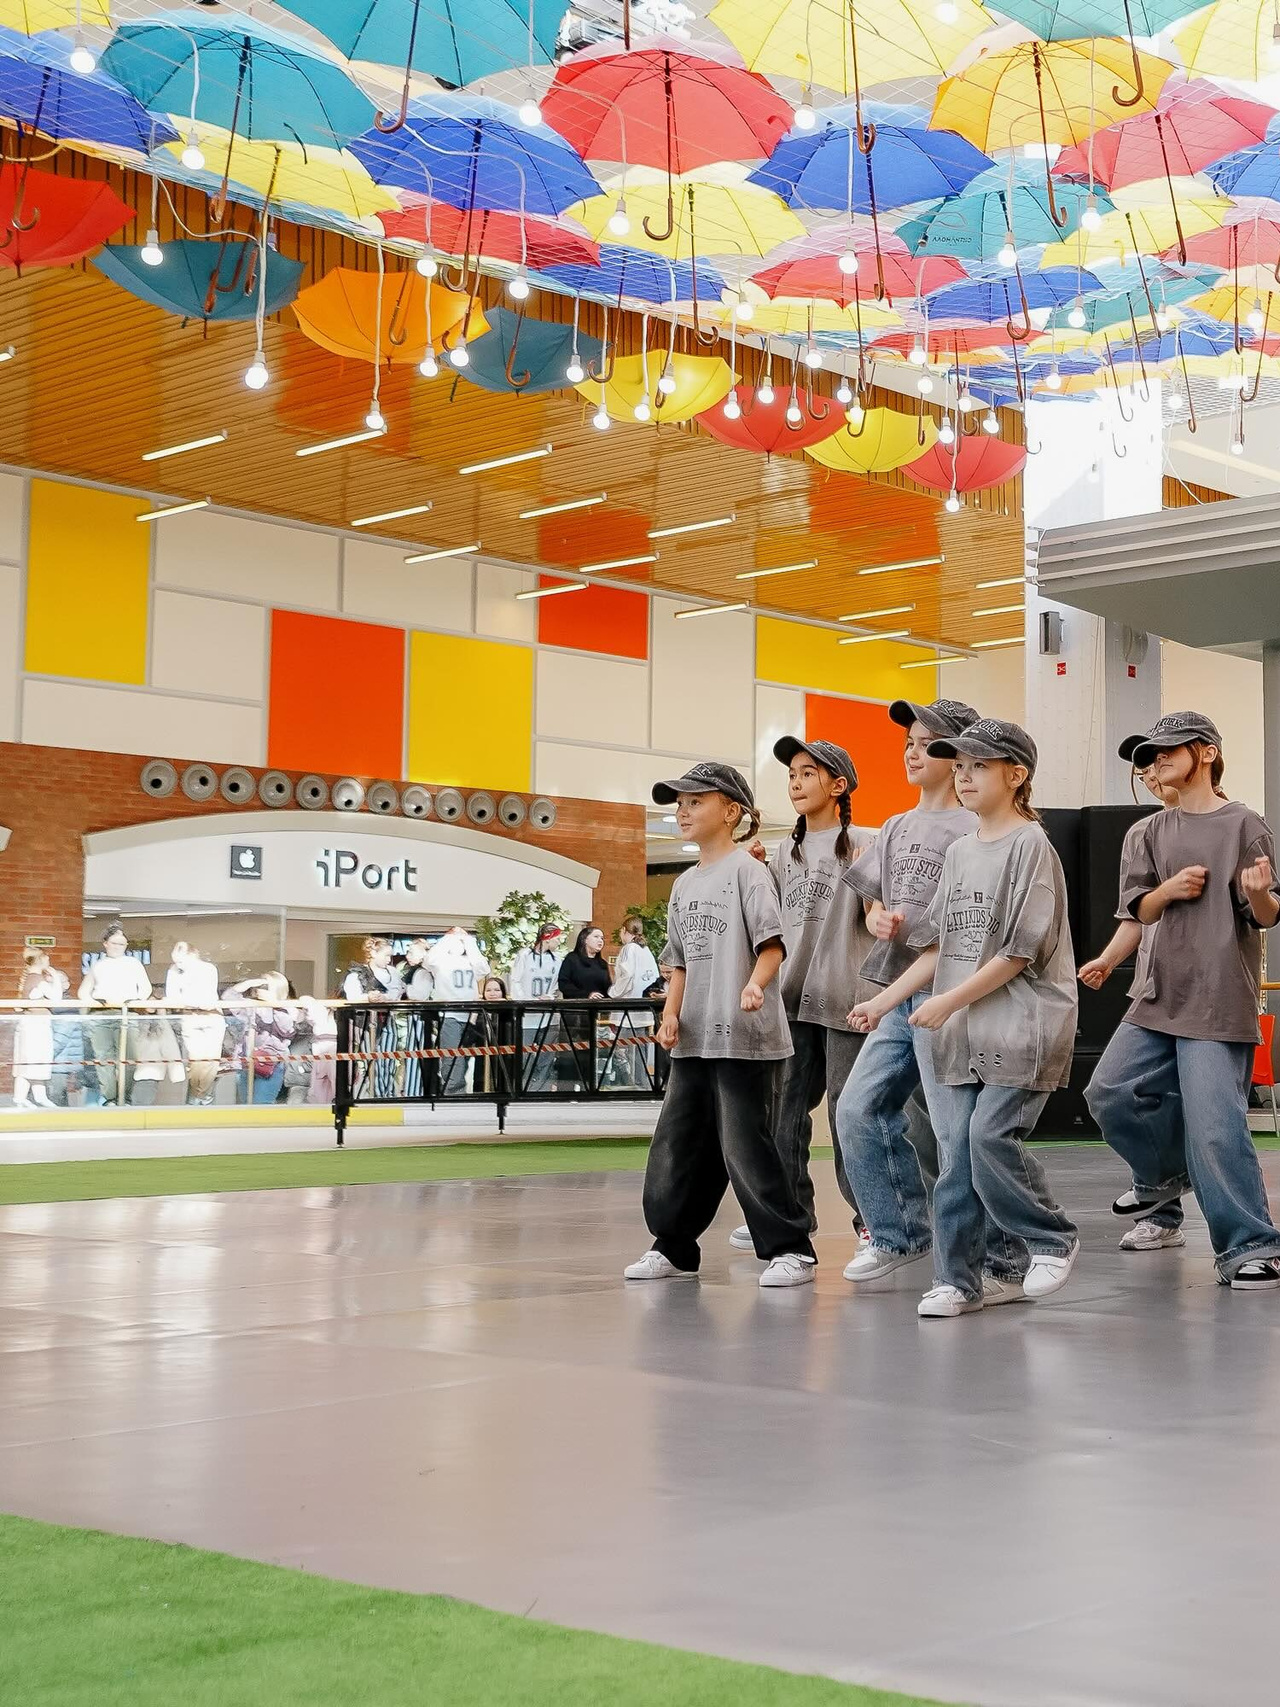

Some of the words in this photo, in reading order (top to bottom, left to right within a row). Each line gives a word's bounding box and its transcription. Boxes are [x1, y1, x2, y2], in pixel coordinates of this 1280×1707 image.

[315, 848, 418, 892] iPort
[452, 968, 475, 989] 07
[531, 976, 553, 997] 07
